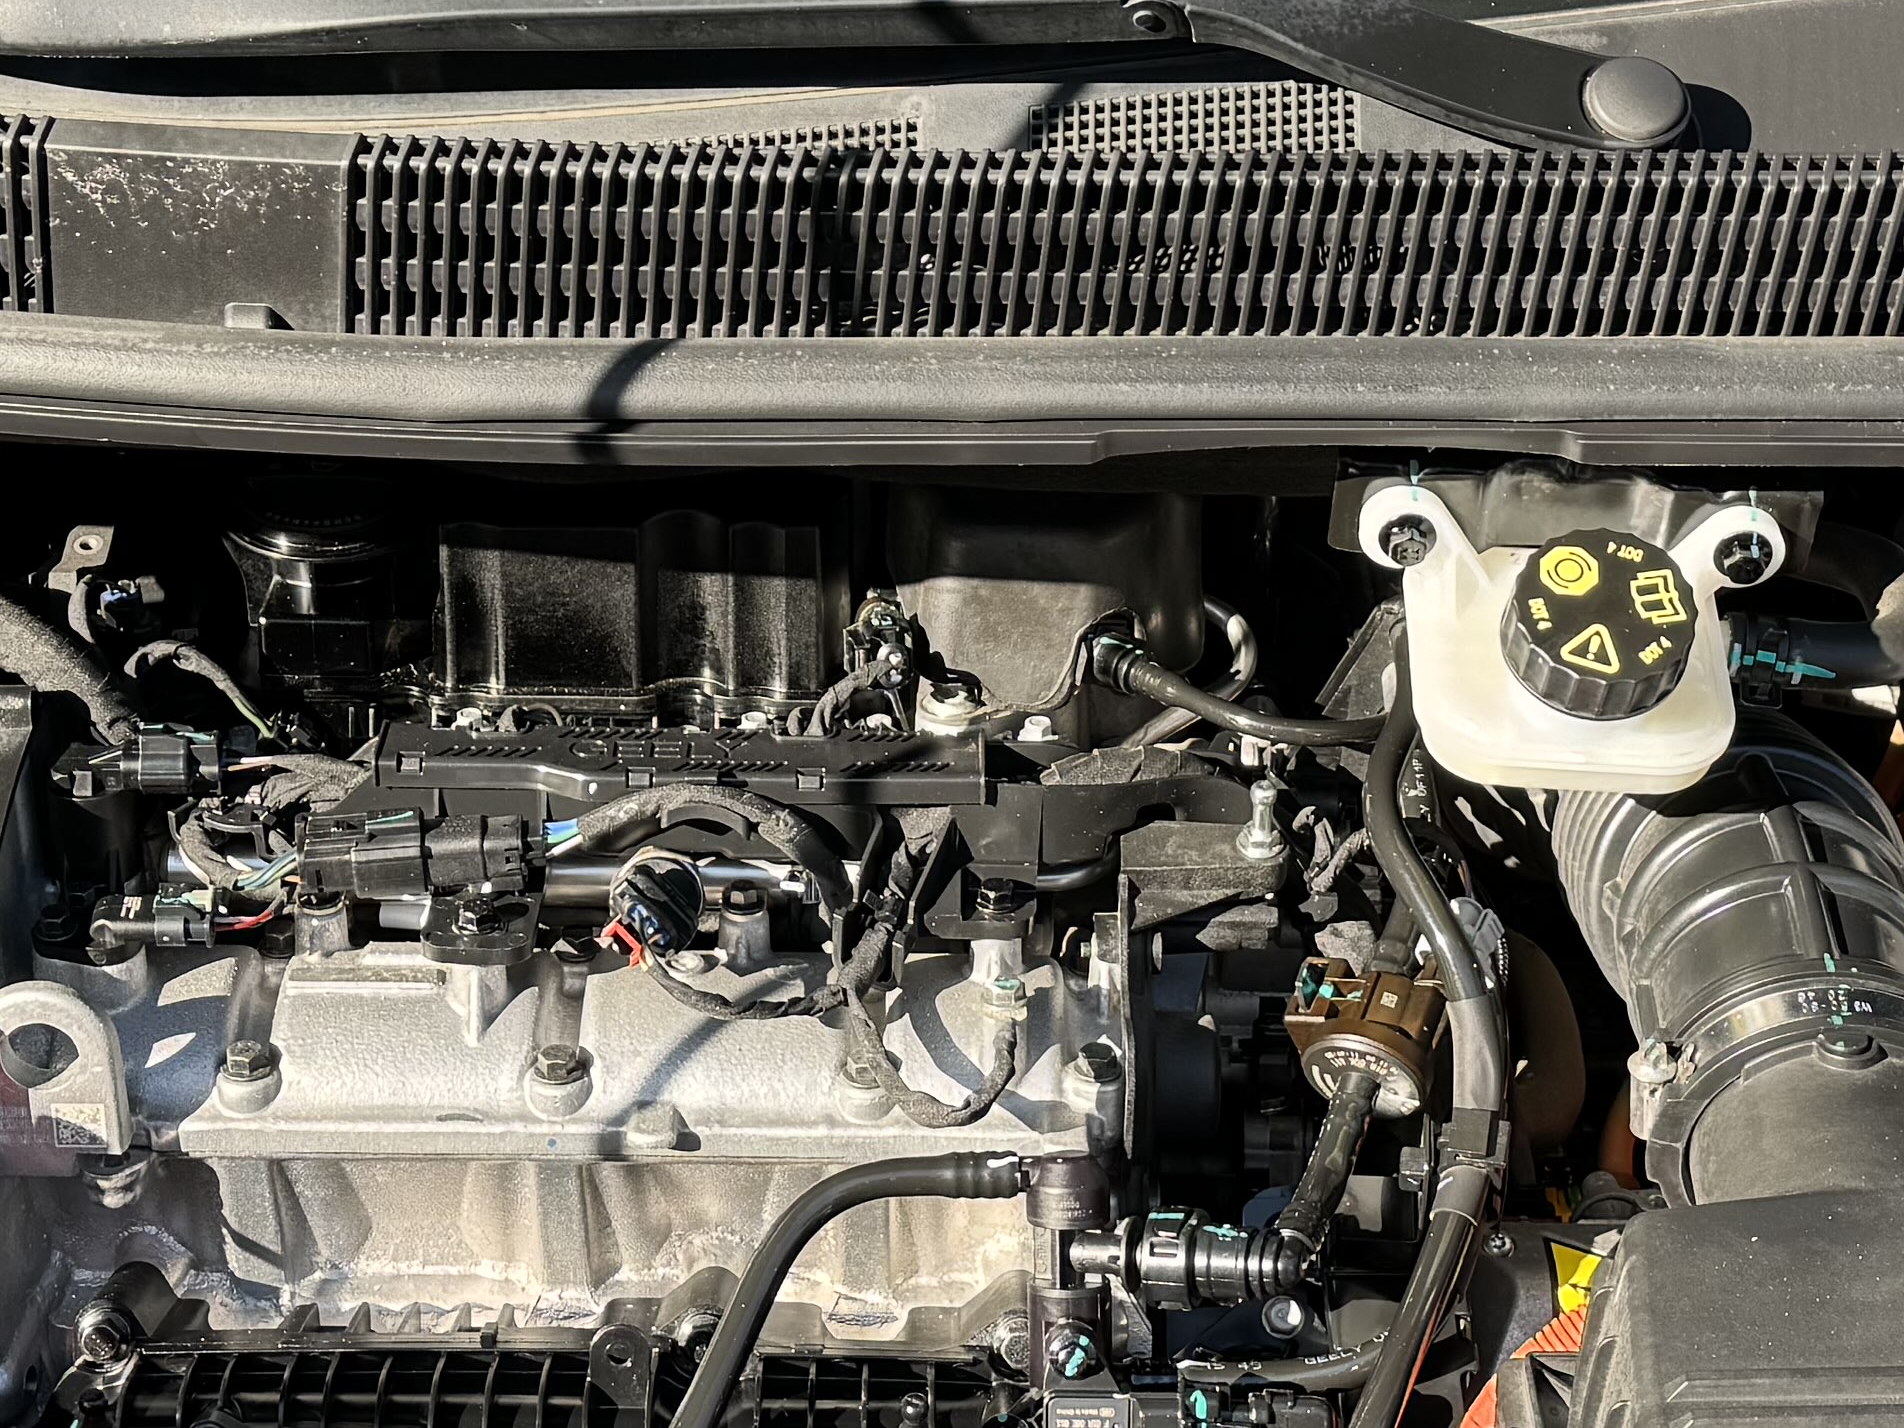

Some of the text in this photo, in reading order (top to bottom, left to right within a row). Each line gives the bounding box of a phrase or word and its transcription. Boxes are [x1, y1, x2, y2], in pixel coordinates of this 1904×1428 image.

[1607, 541, 1644, 563] DOT 4
[1528, 598, 1552, 631] DOT 4
[1639, 635, 1673, 665] DOT 4
[569, 739, 748, 758] GEELY
